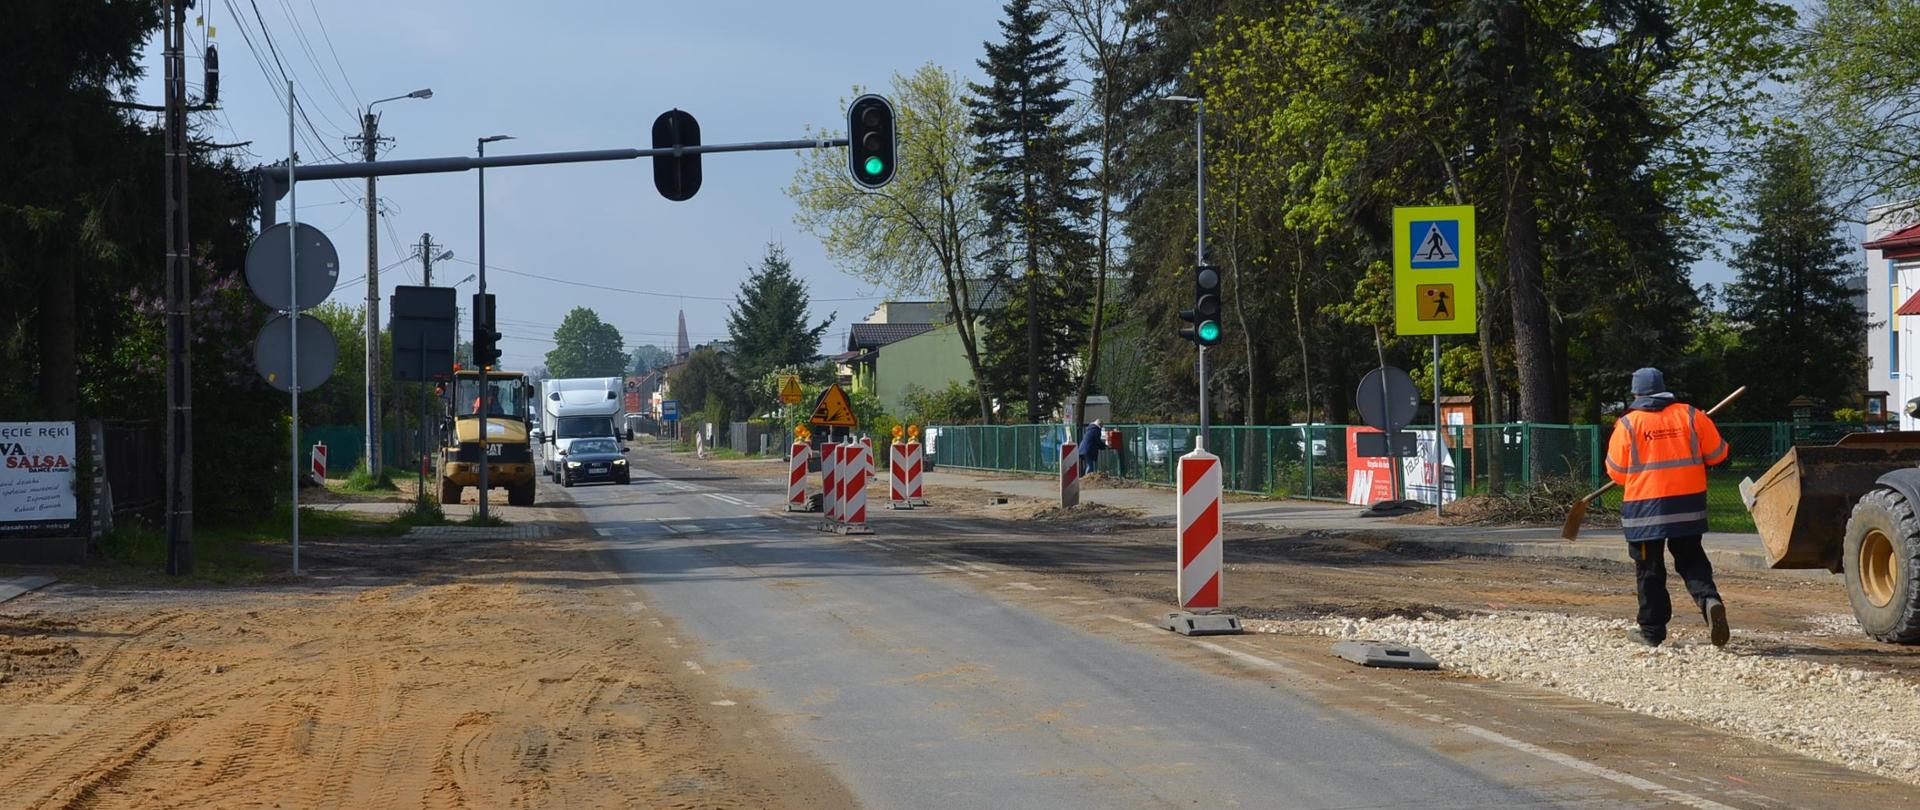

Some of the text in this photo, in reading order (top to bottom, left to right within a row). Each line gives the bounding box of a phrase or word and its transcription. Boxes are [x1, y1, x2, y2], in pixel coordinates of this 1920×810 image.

[0, 427, 69, 439] ĘCIE RĘKI
[6, 455, 69, 469] SALSA
